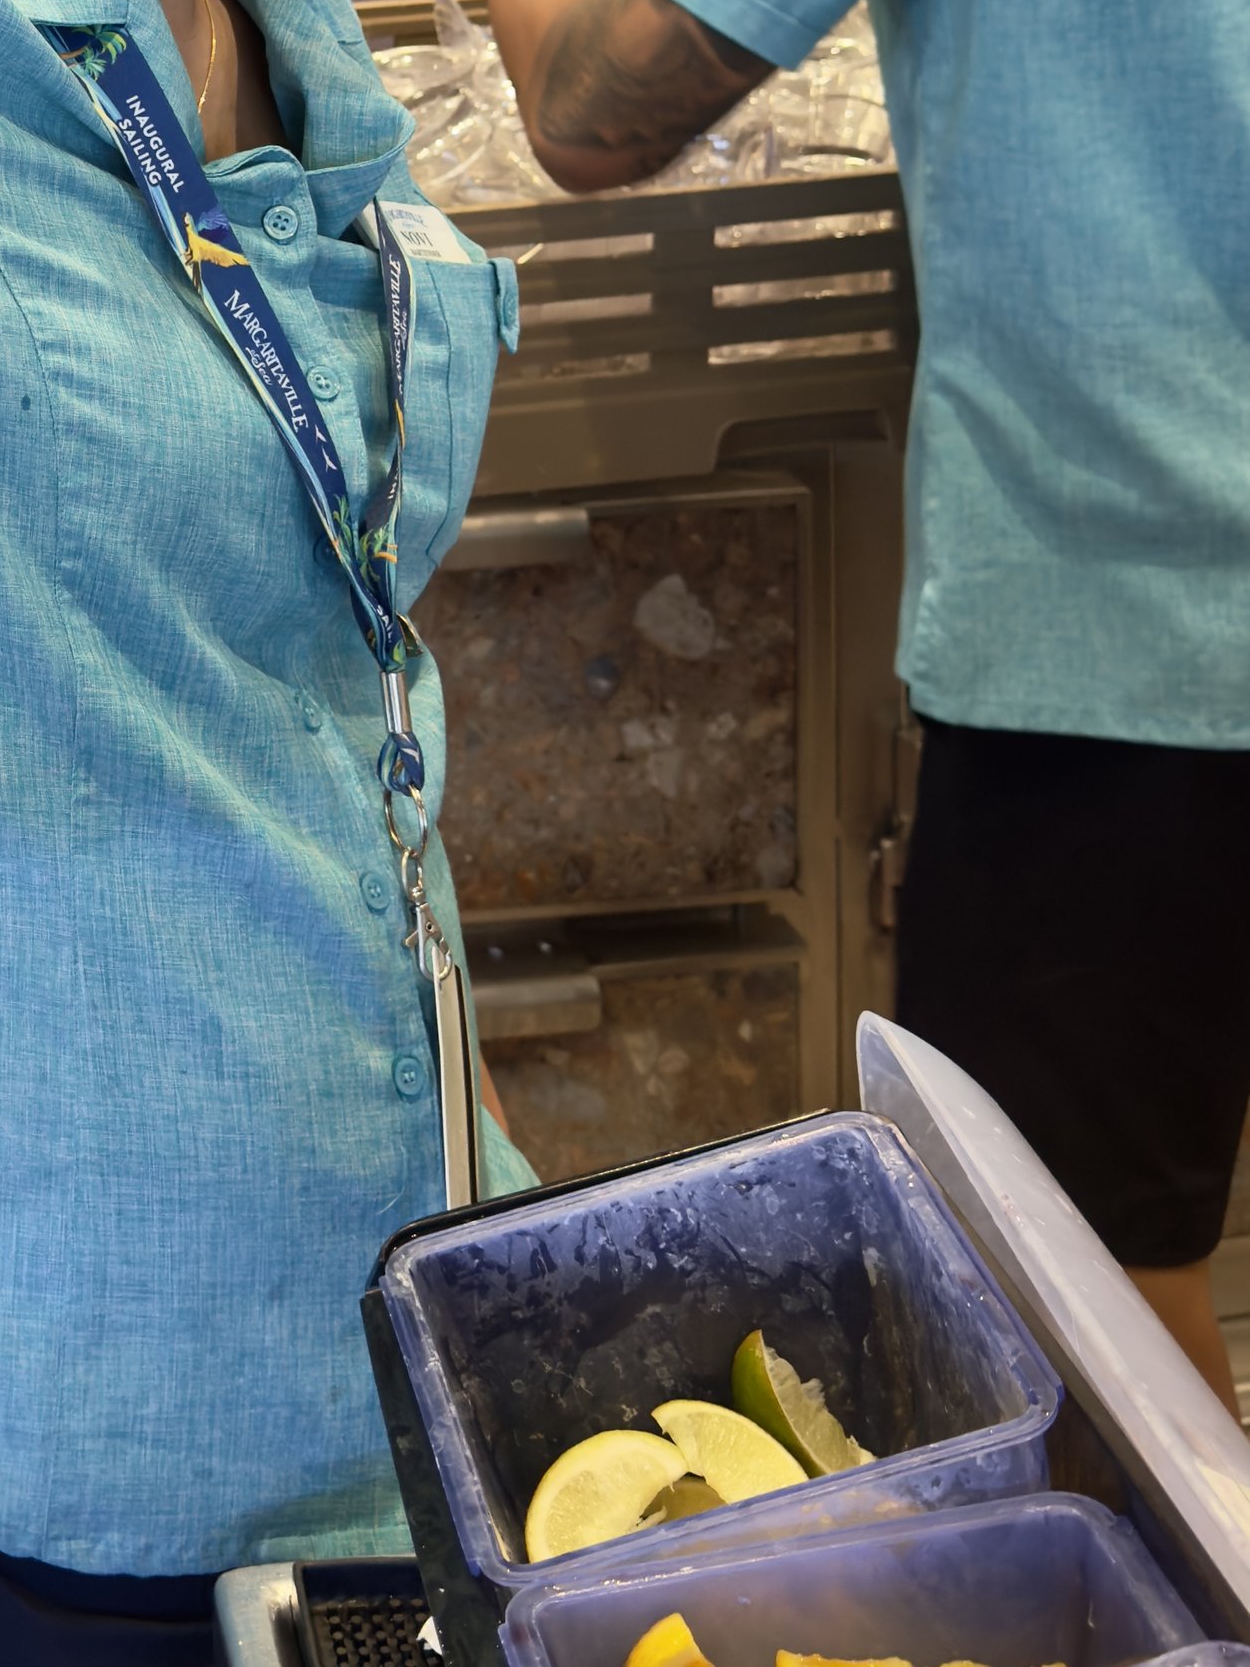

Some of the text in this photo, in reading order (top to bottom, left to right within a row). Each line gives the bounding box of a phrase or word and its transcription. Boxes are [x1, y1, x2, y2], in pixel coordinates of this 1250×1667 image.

[118, 117, 163, 187] SAILING
[125, 94, 185, 194] INAUGURAL
[400, 229, 435, 248] NOVI
[223, 289, 309, 433] MARGARITAVILLE
